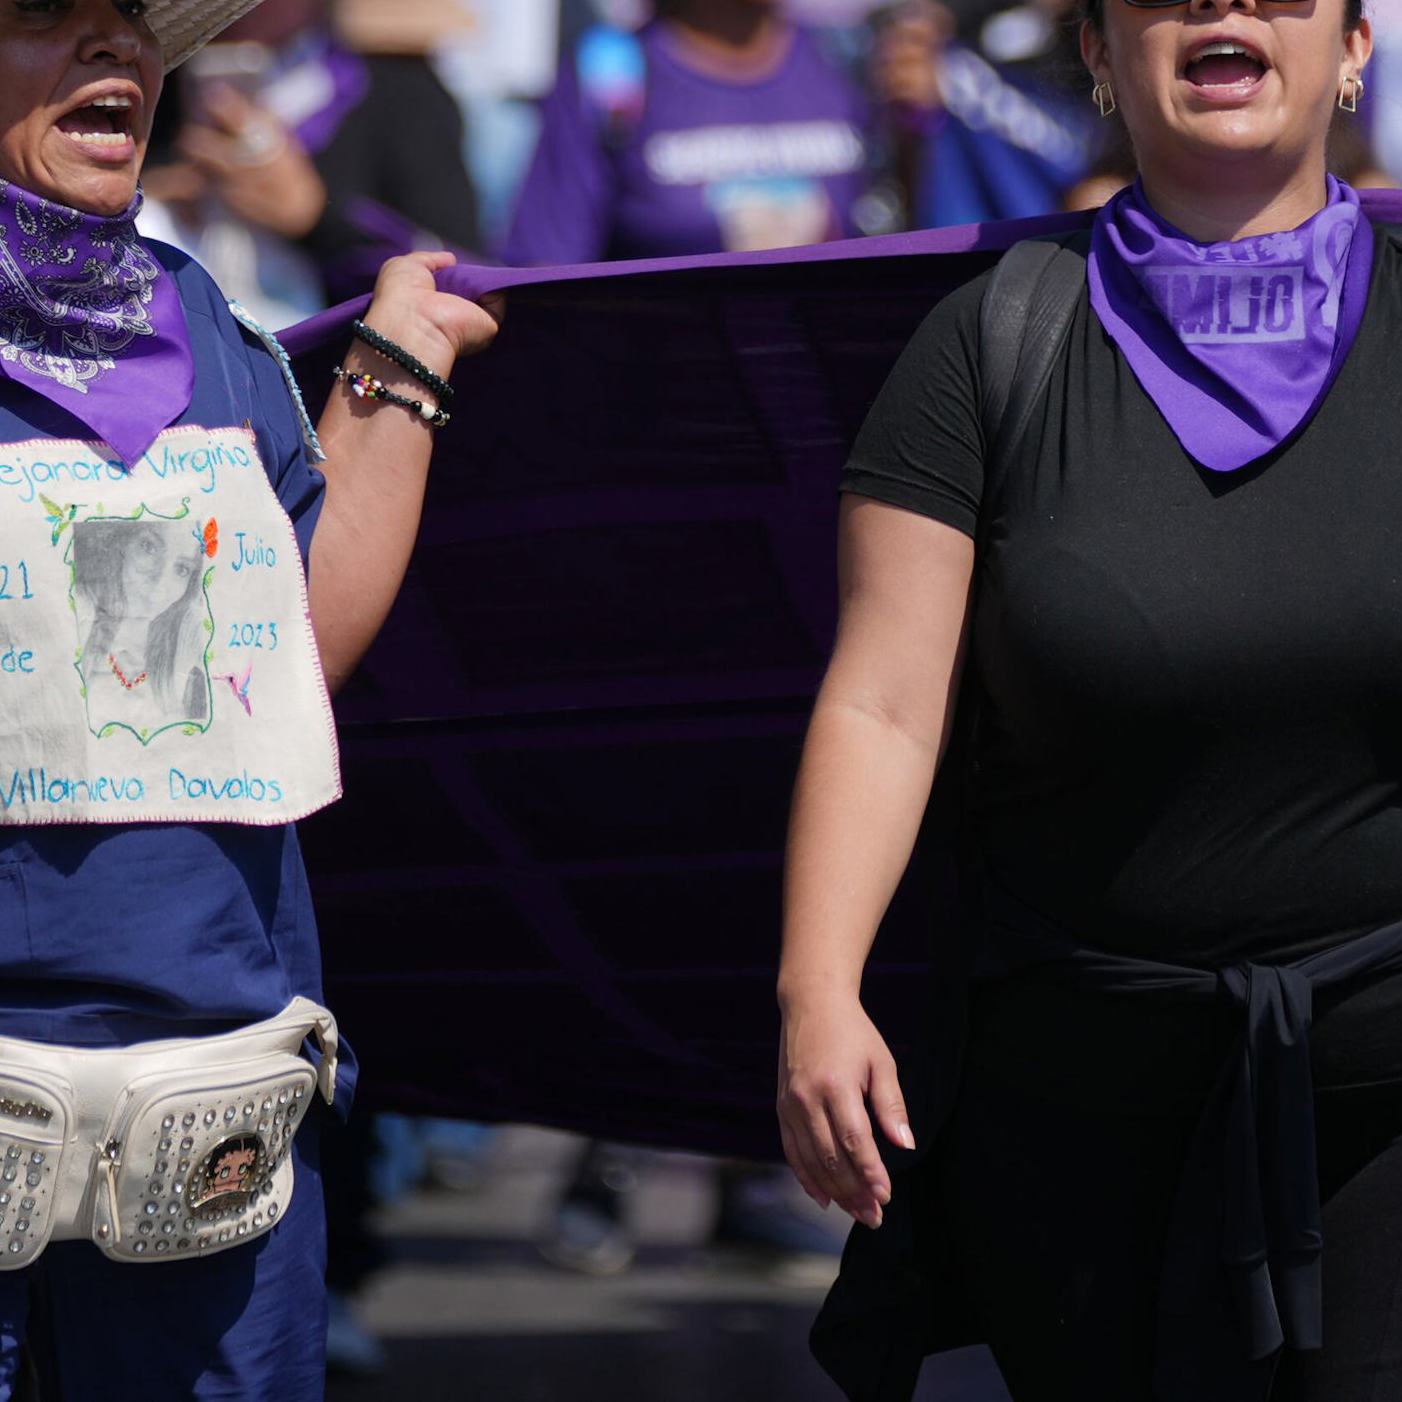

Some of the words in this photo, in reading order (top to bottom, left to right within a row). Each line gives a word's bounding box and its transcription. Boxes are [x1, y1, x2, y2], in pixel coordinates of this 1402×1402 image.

[231, 532, 277, 571] Julio
[228, 622, 279, 651] 2023
[1, 644, 35, 673] de
[169, 766, 283, 802] Davalos
